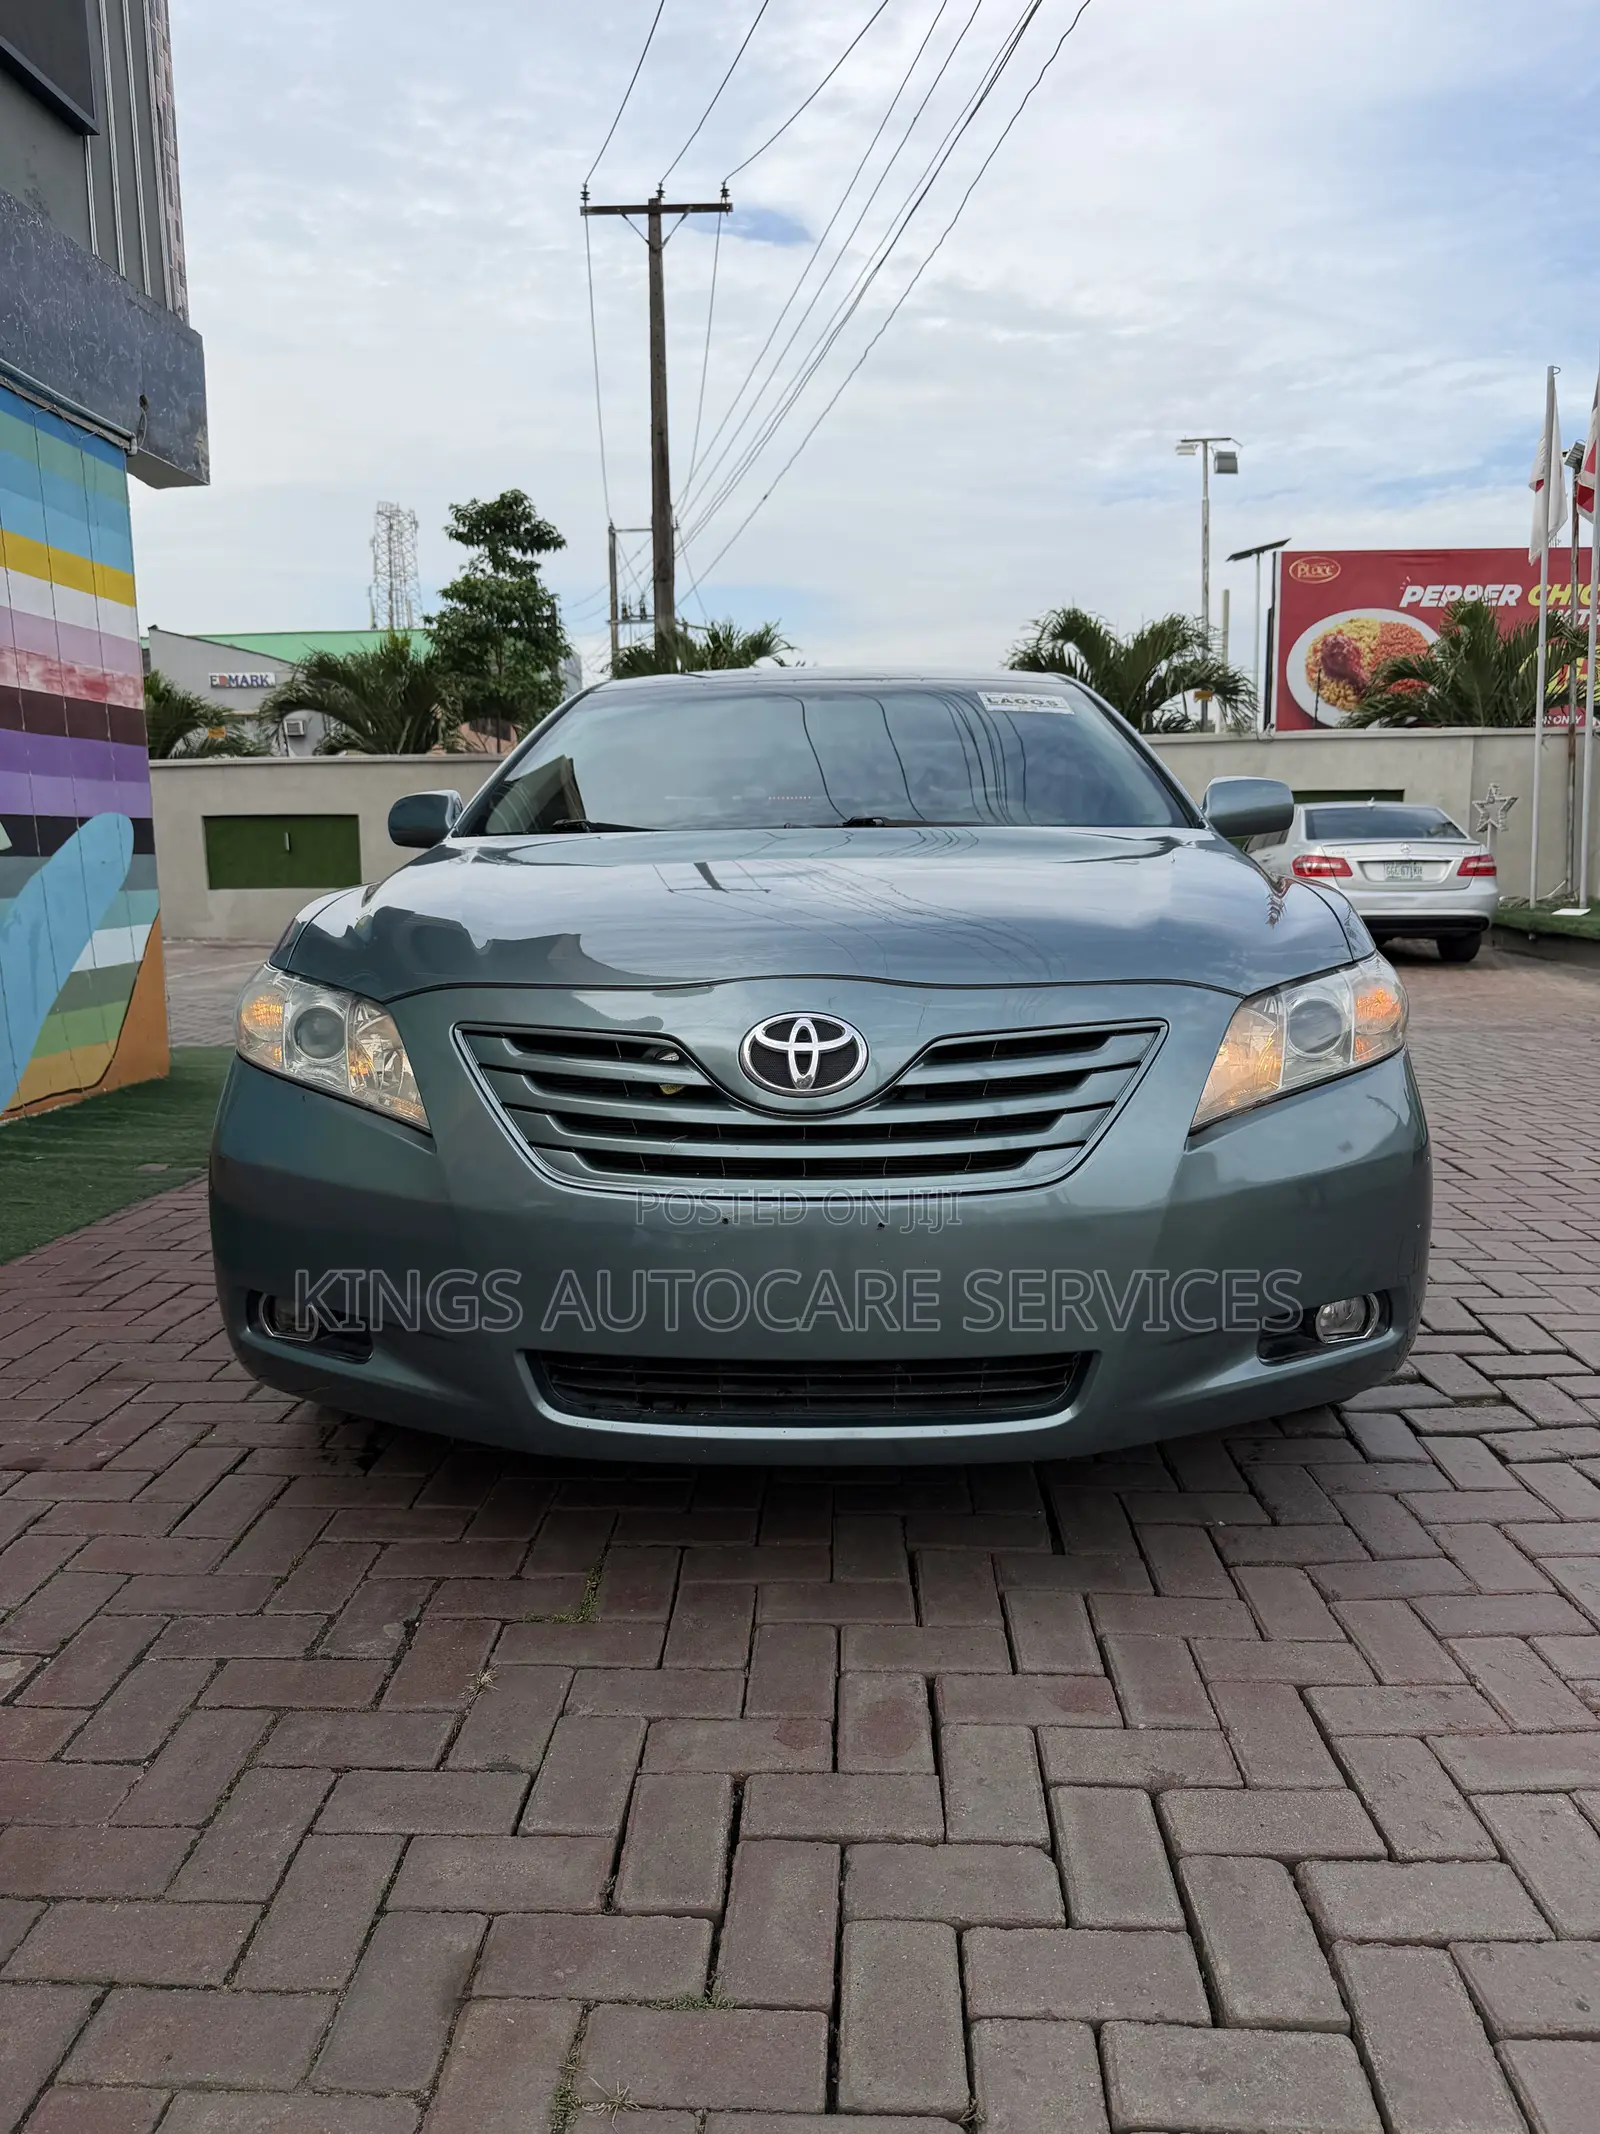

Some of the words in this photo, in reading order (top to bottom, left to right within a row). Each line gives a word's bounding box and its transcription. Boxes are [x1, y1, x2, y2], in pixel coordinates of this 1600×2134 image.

[1399, 584, 1523, 608] PEPPER
[209, 674, 271, 689] EDMARK
[1553, 715, 1582, 725] ONY
